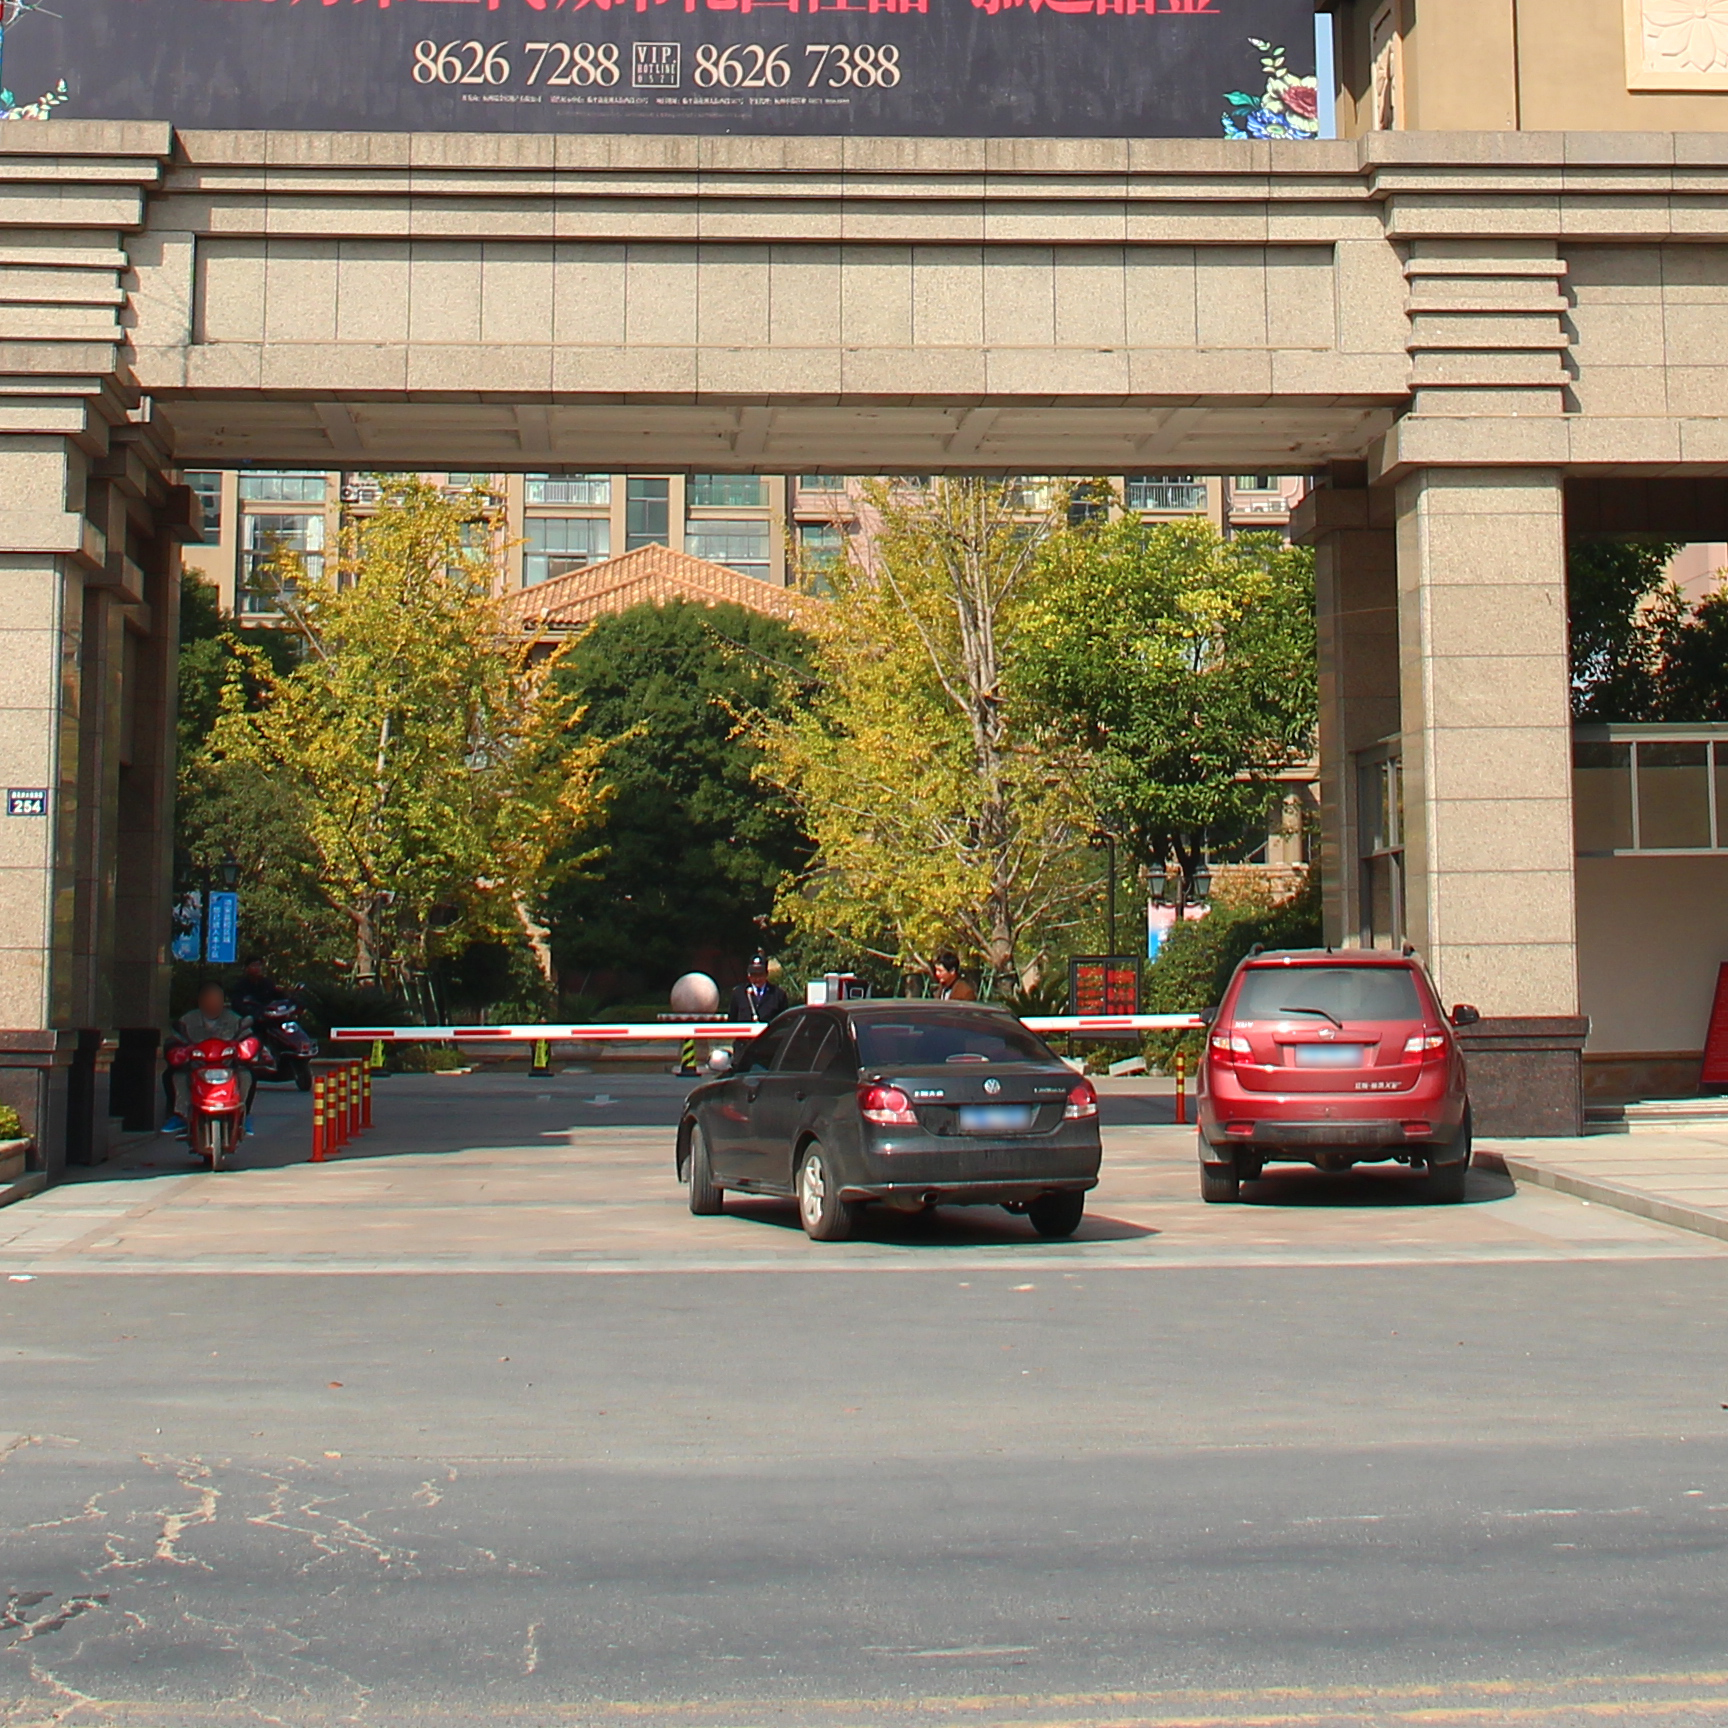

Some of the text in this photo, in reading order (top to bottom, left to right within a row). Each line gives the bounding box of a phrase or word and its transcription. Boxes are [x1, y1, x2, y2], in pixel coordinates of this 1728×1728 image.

[411, 39, 621, 86] 8626 7288
[693, 43, 901, 88] 8626 7388
[12, 799, 41, 813] 254
